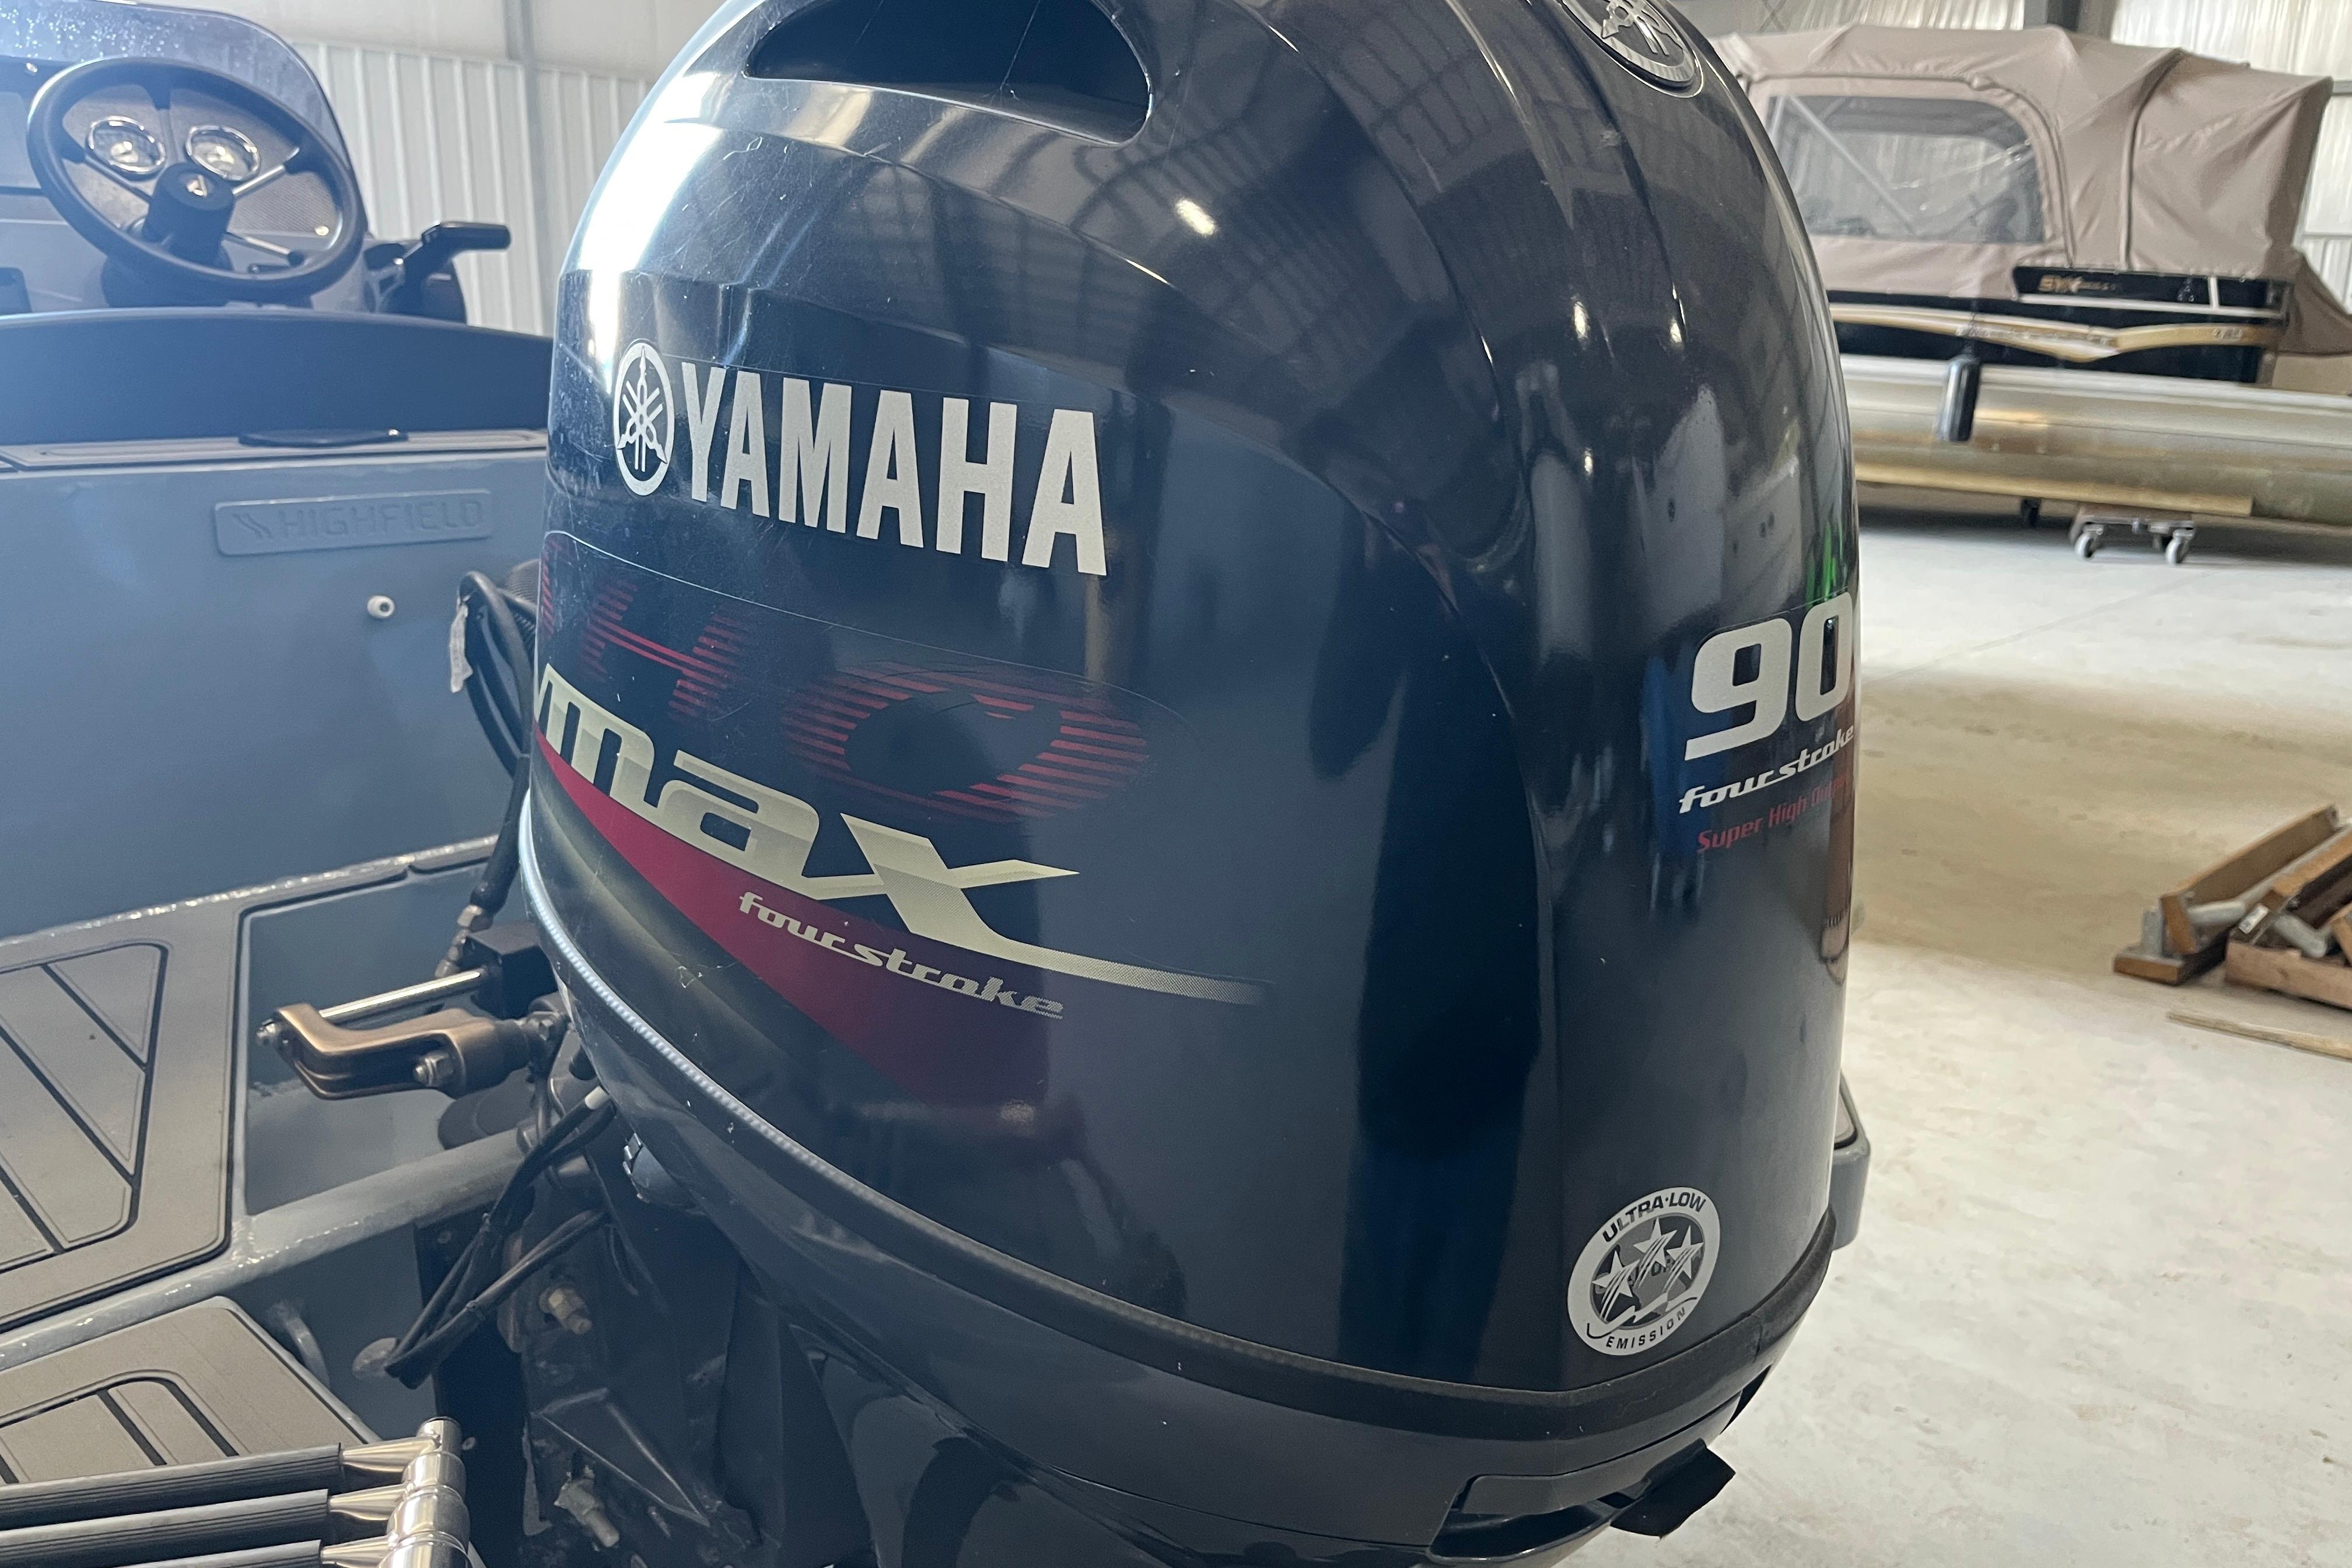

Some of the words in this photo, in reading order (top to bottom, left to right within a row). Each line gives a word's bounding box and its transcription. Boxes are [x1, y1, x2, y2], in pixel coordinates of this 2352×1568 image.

[681, 360, 1108, 577] YAMAHA
[277, 497, 484, 538] HIGHFIELD
[1684, 592, 1854, 761] 90
[1696, 817, 1763, 853] Super
[1768, 794, 1807, 828] High
[1605, 1306, 1685, 1349] EMISSION
